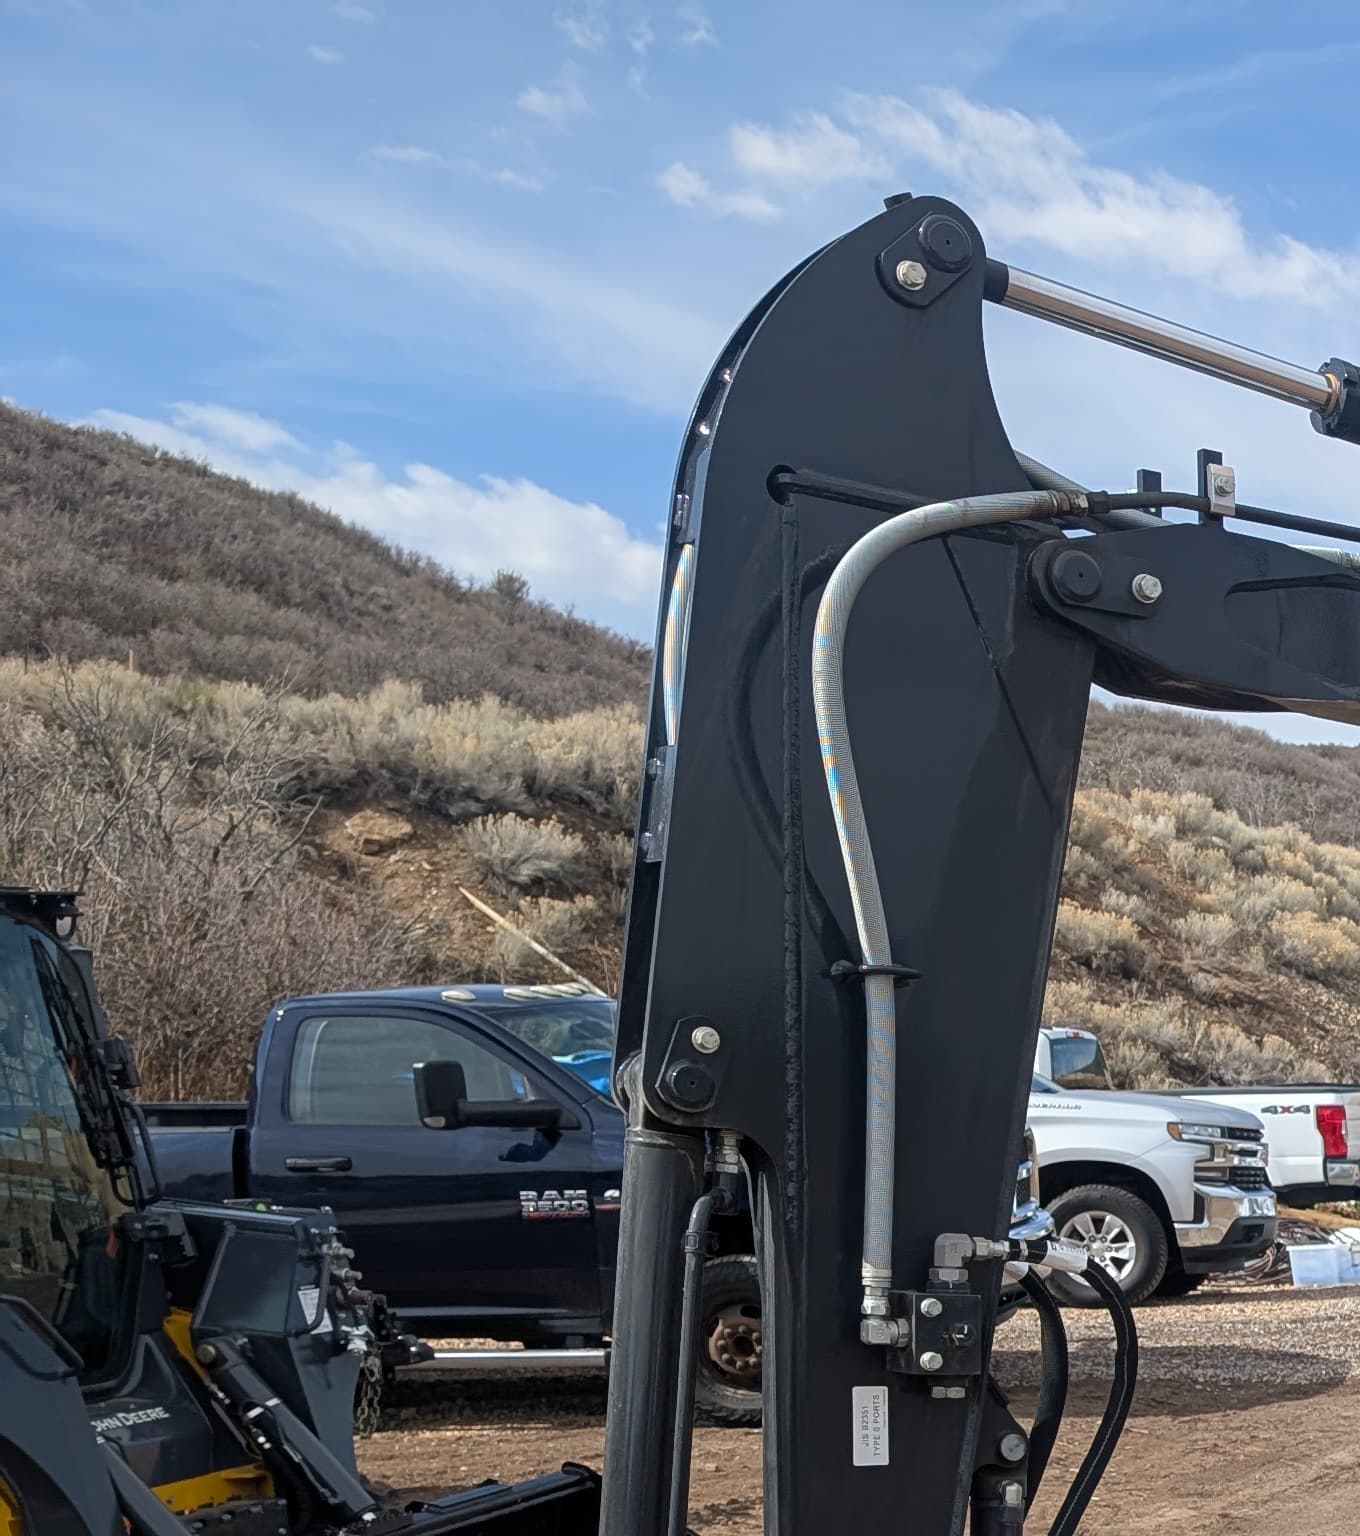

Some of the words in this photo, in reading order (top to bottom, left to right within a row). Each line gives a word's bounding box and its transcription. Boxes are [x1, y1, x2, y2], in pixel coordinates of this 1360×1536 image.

[519, 1189, 588, 1201] RAM
[116, 1407, 170, 1425] DEERE
[872, 1394, 881, 1424] PORTS
[872, 1434, 881, 1457] TYPE
